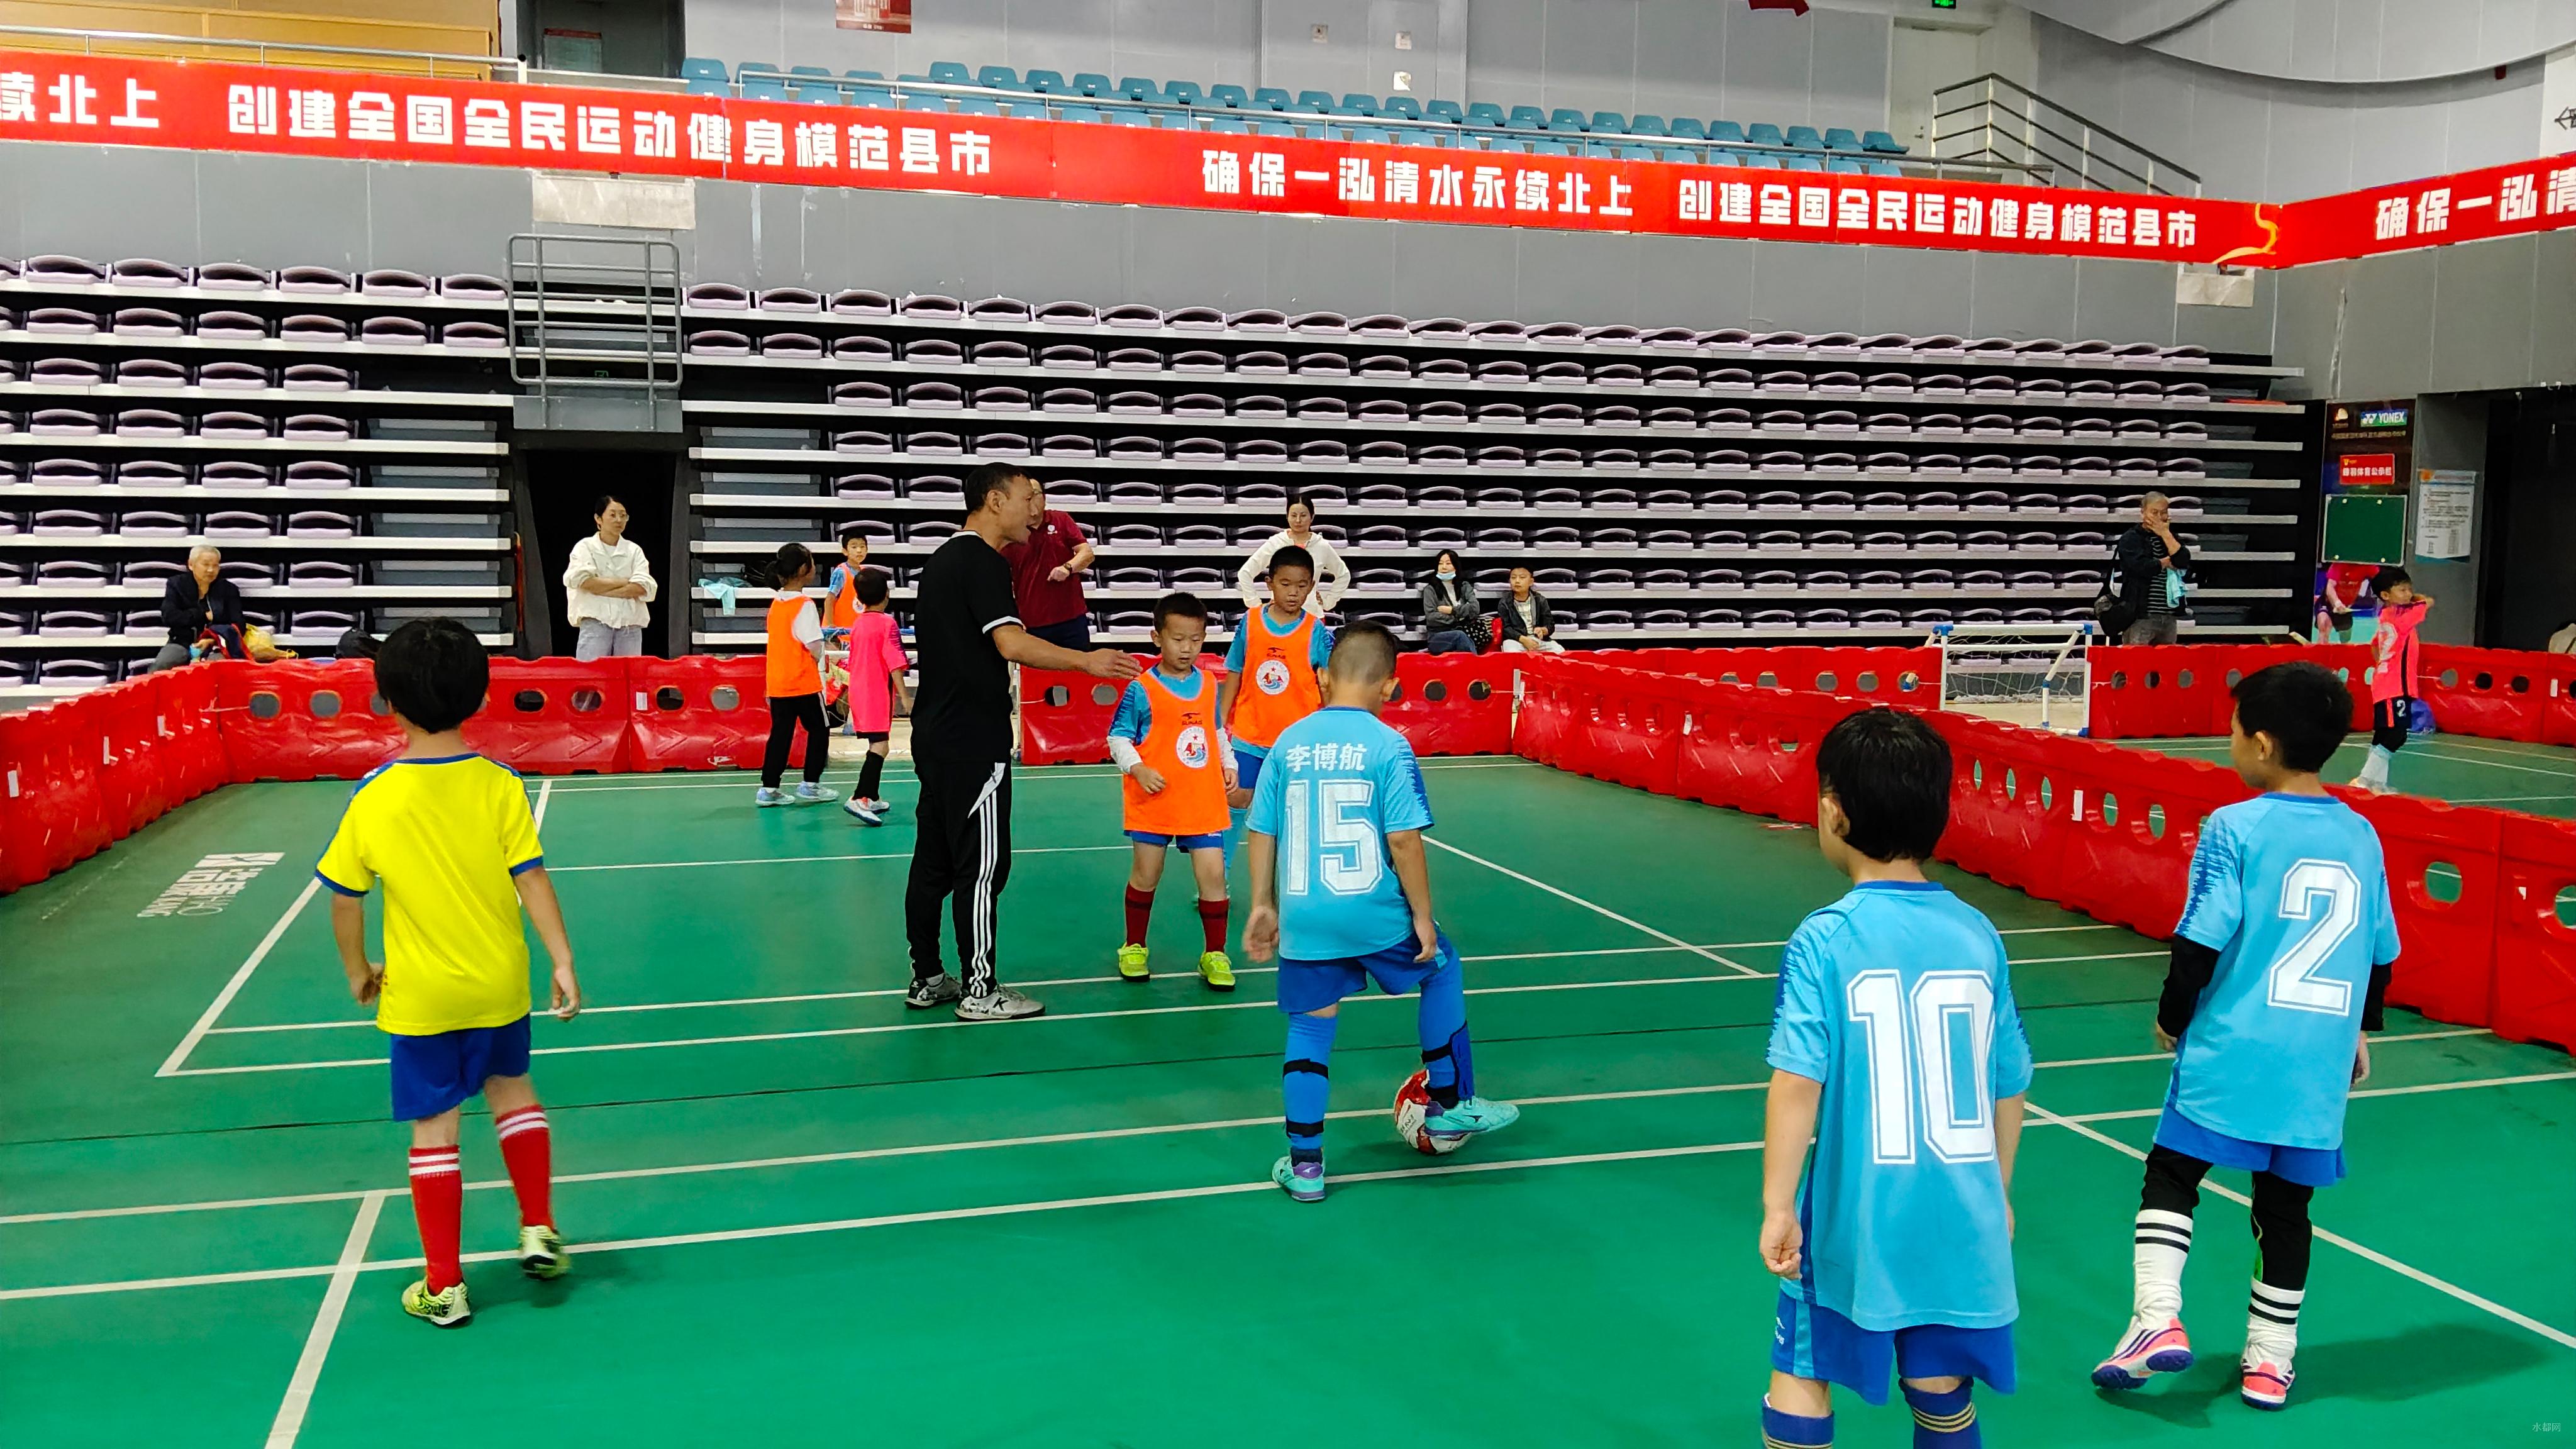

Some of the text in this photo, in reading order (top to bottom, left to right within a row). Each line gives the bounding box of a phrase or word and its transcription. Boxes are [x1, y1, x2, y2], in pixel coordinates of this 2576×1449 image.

[0, 72, 991, 176] 续北上 创建全国全民运动健身模范县市
[1202, 150, 2196, 248] 确保一泓清水永续北上 创建全国全民运动健身模范县市
[2379, 412, 2404, 423] YONEX
[1285, 743, 1367, 772] 李博航
[2396, 699, 2406, 718] 2
[1285, 779, 1382, 896] 15
[2267, 858, 2362, 1017] 2
[1846, 969, 1996, 1165] 10
